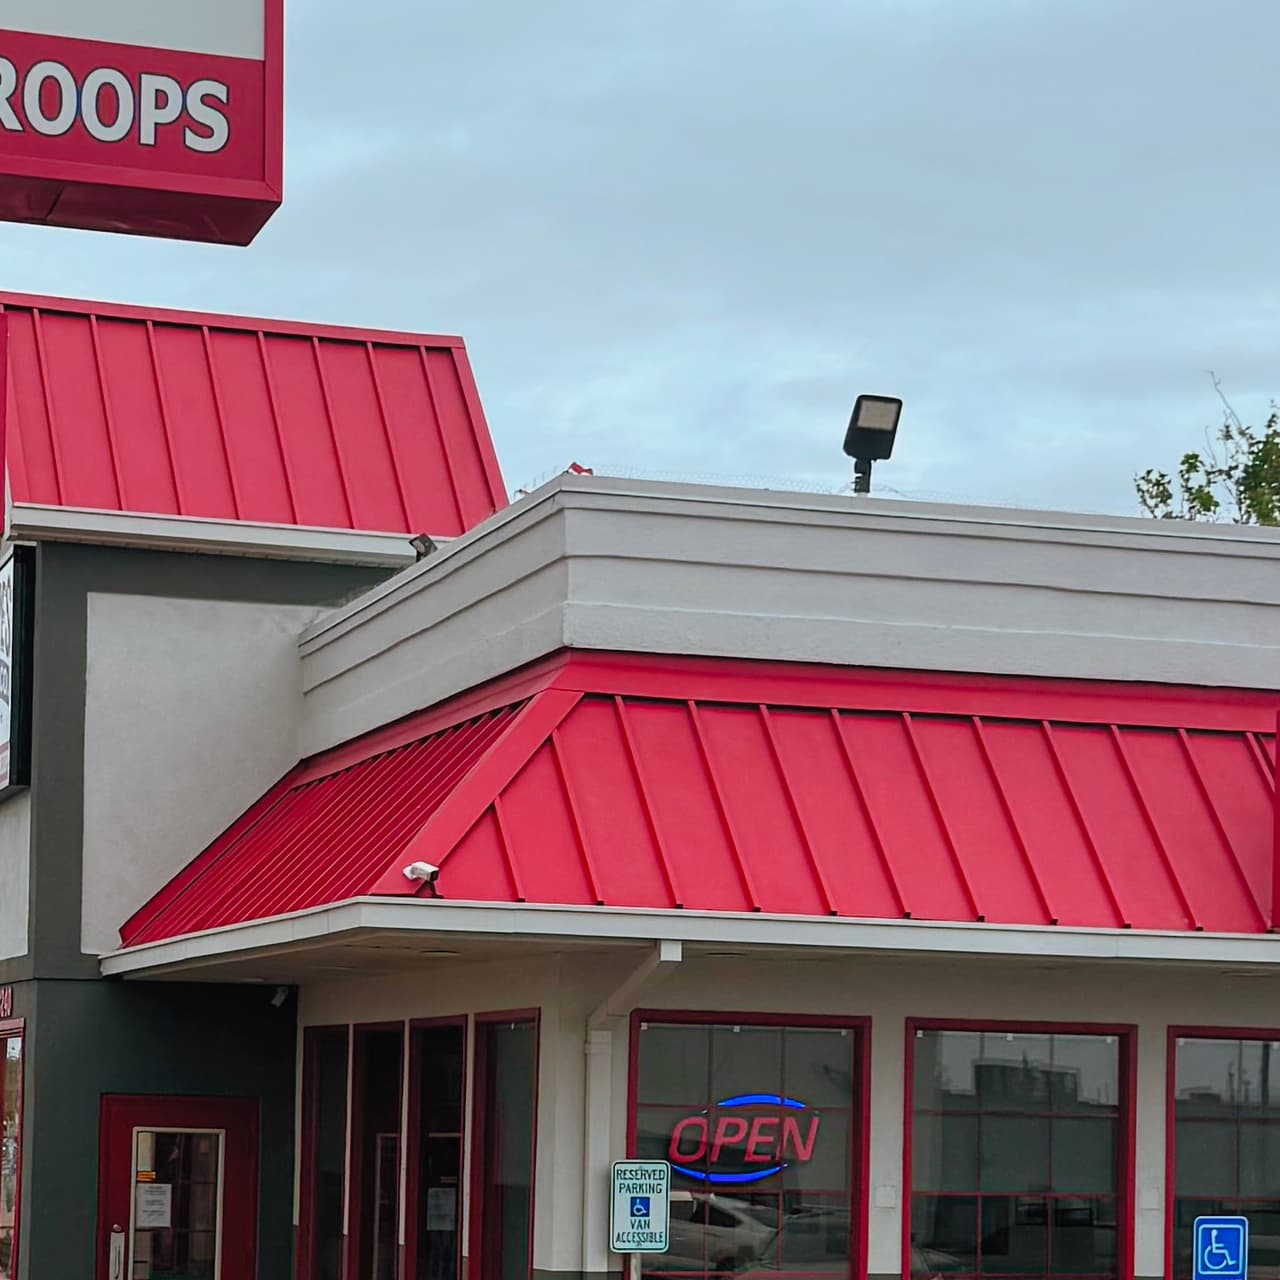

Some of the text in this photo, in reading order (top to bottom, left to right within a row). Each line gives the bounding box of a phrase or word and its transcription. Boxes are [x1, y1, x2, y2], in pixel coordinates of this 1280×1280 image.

[668, 1115, 820, 1163] OPEN
[616, 1168, 666, 1181] RESERVED
[619, 1182, 663, 1194] PARKING
[630, 1218, 651, 1230] VAN
[616, 1231, 665, 1244] ACCESSIBLE
